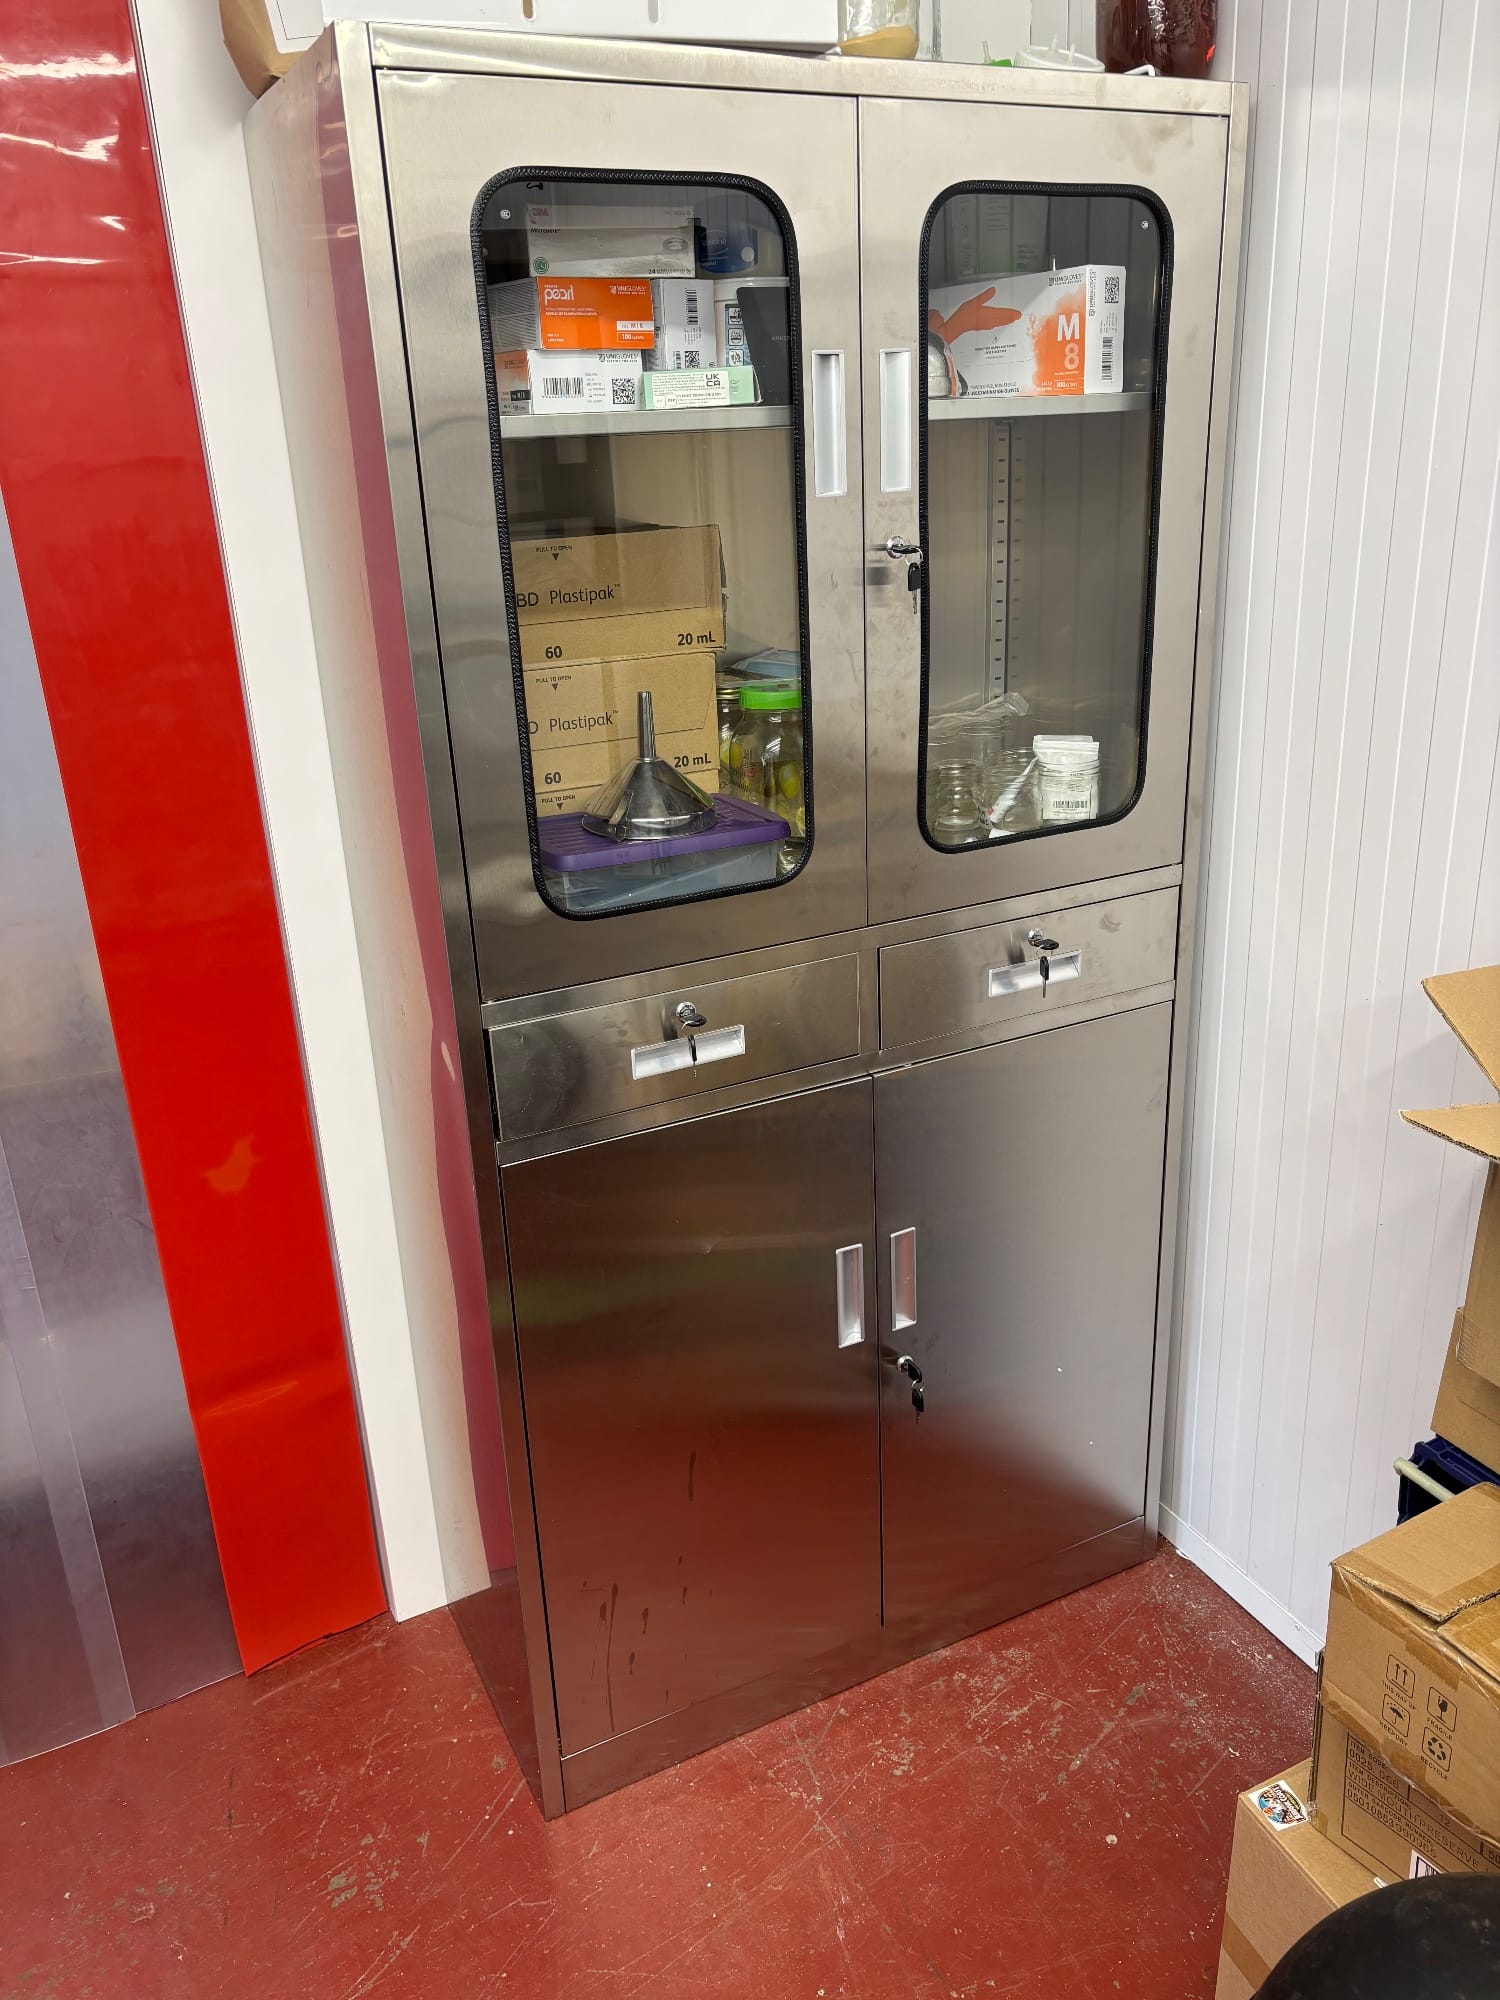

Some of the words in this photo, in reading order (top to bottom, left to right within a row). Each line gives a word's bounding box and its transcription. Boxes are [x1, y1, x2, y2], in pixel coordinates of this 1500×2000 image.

[544, 285, 574, 306] pearl
[1057, 312, 1080, 341] M
[1064, 342, 1080, 370] 8
[705, 373, 720, 381] UK
[706, 380, 721, 388] CA
[516, 591, 539, 608] BD
[677, 633, 693, 646] 20
[696, 631, 717, 644] mL
[545, 645, 562, 659] 60
[674, 755, 689, 768] 20
[692, 753, 712, 766] mL
[544, 771, 562, 785] 60
[1420, 1755, 1448, 1780] RECYCLE
[1349, 1770, 1375, 1793] WIDE
[1377, 1789, 1418, 1822] MOUTH
[1419, 1818, 1481, 1868] PRESERVE
[1439, 1814, 1451, 1827] 12
